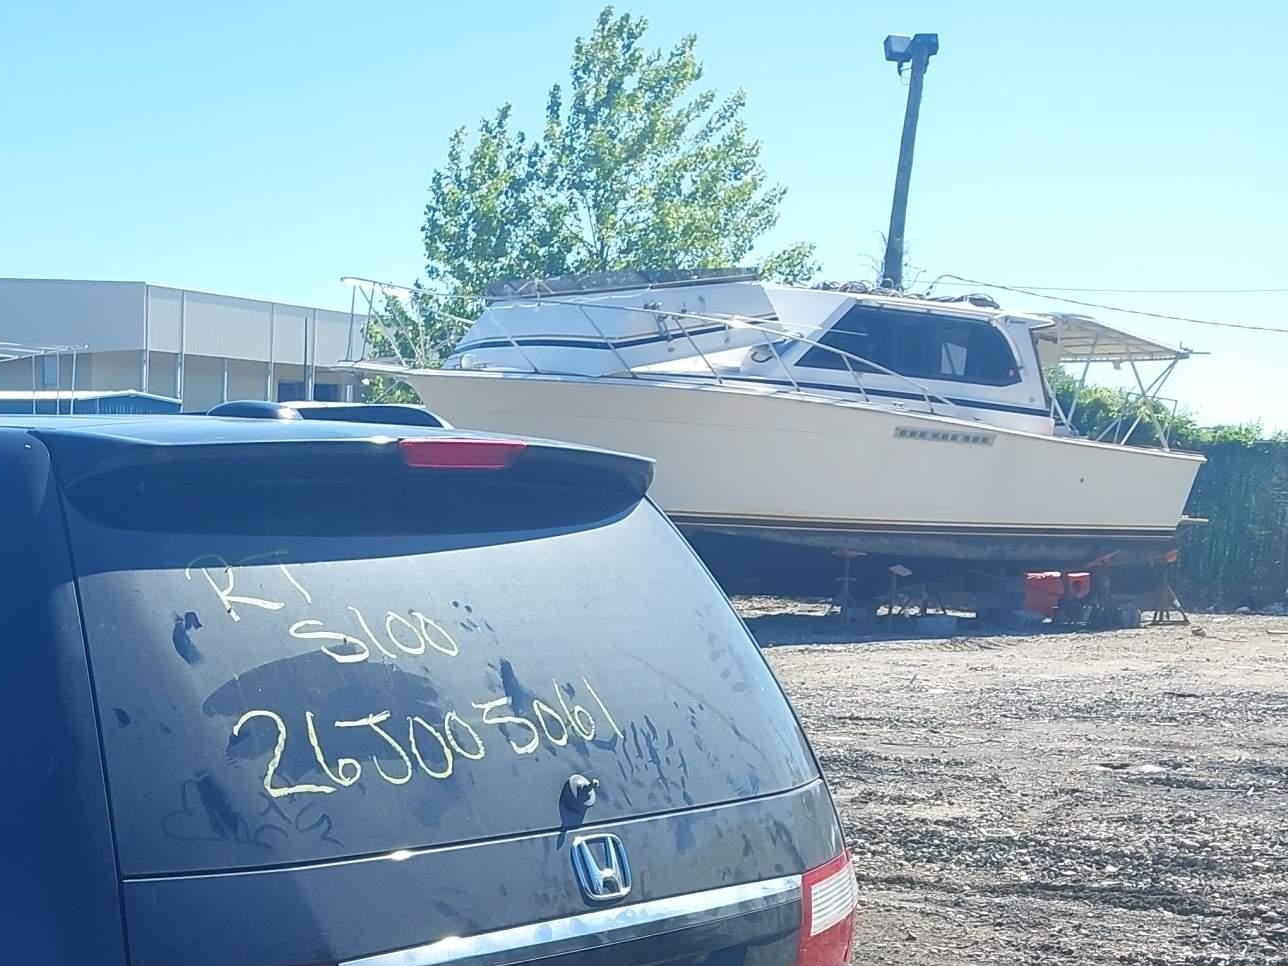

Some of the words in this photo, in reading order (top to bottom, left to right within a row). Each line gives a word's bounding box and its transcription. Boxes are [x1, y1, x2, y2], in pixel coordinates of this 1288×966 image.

[185, 548, 312, 621] RT
[288, 605, 459, 664] S100
[232, 676, 625, 798] 26J005061
